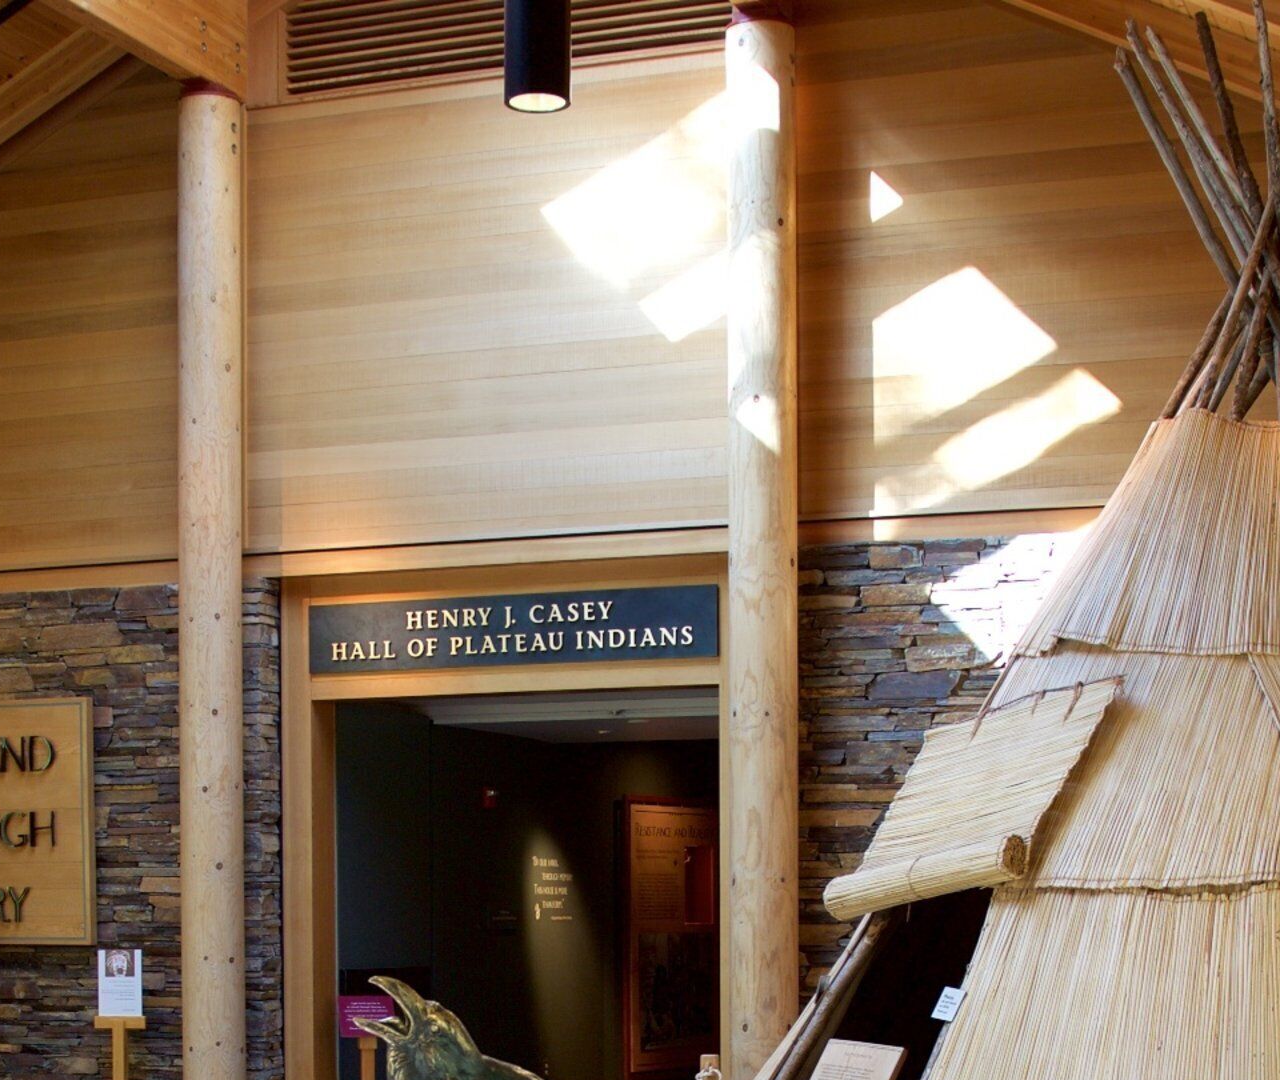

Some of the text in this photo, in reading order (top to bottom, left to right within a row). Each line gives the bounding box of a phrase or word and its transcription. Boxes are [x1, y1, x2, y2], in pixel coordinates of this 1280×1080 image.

[405, 600, 614, 631] HENRY J. CASEY
[331, 625, 694, 662] HALL OF PLATEAU INDIANS
